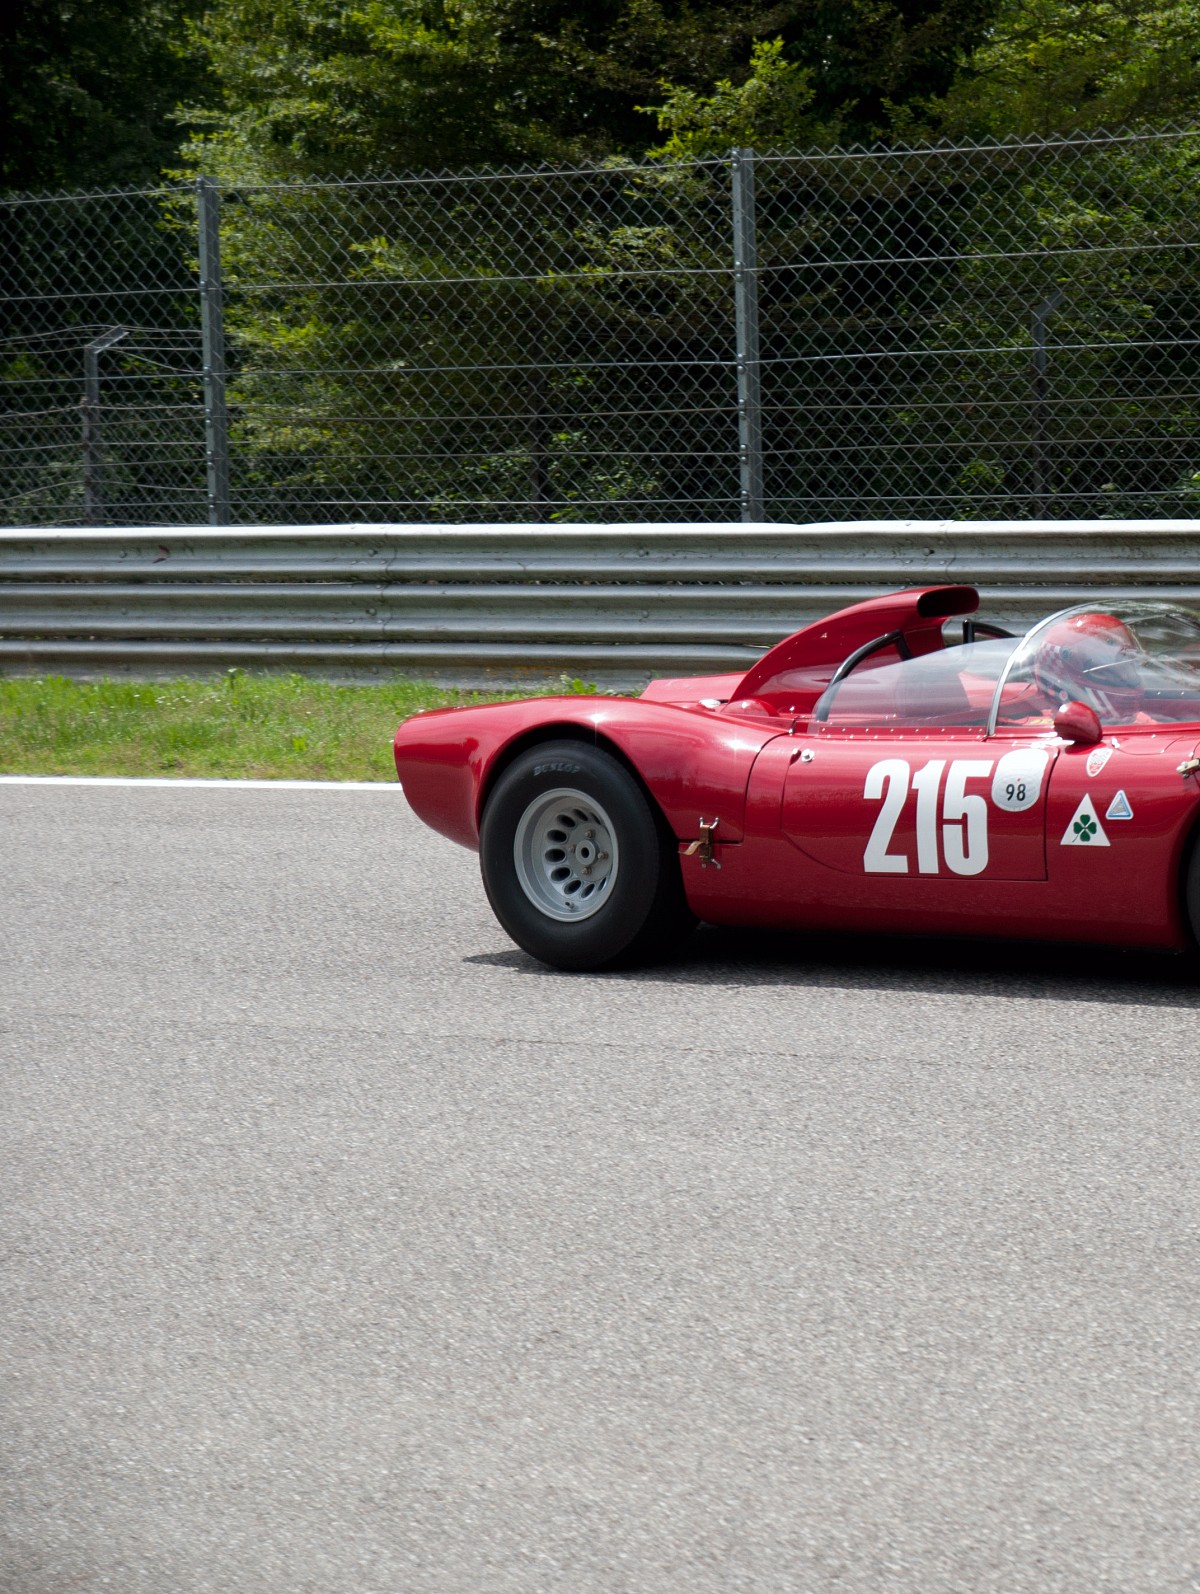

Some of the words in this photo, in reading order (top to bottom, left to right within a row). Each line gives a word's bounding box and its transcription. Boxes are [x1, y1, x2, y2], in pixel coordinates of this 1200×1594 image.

[533, 762, 581, 776] DUNLOP
[1006, 783, 1026, 801] 98
[863, 759, 994, 876] 215
